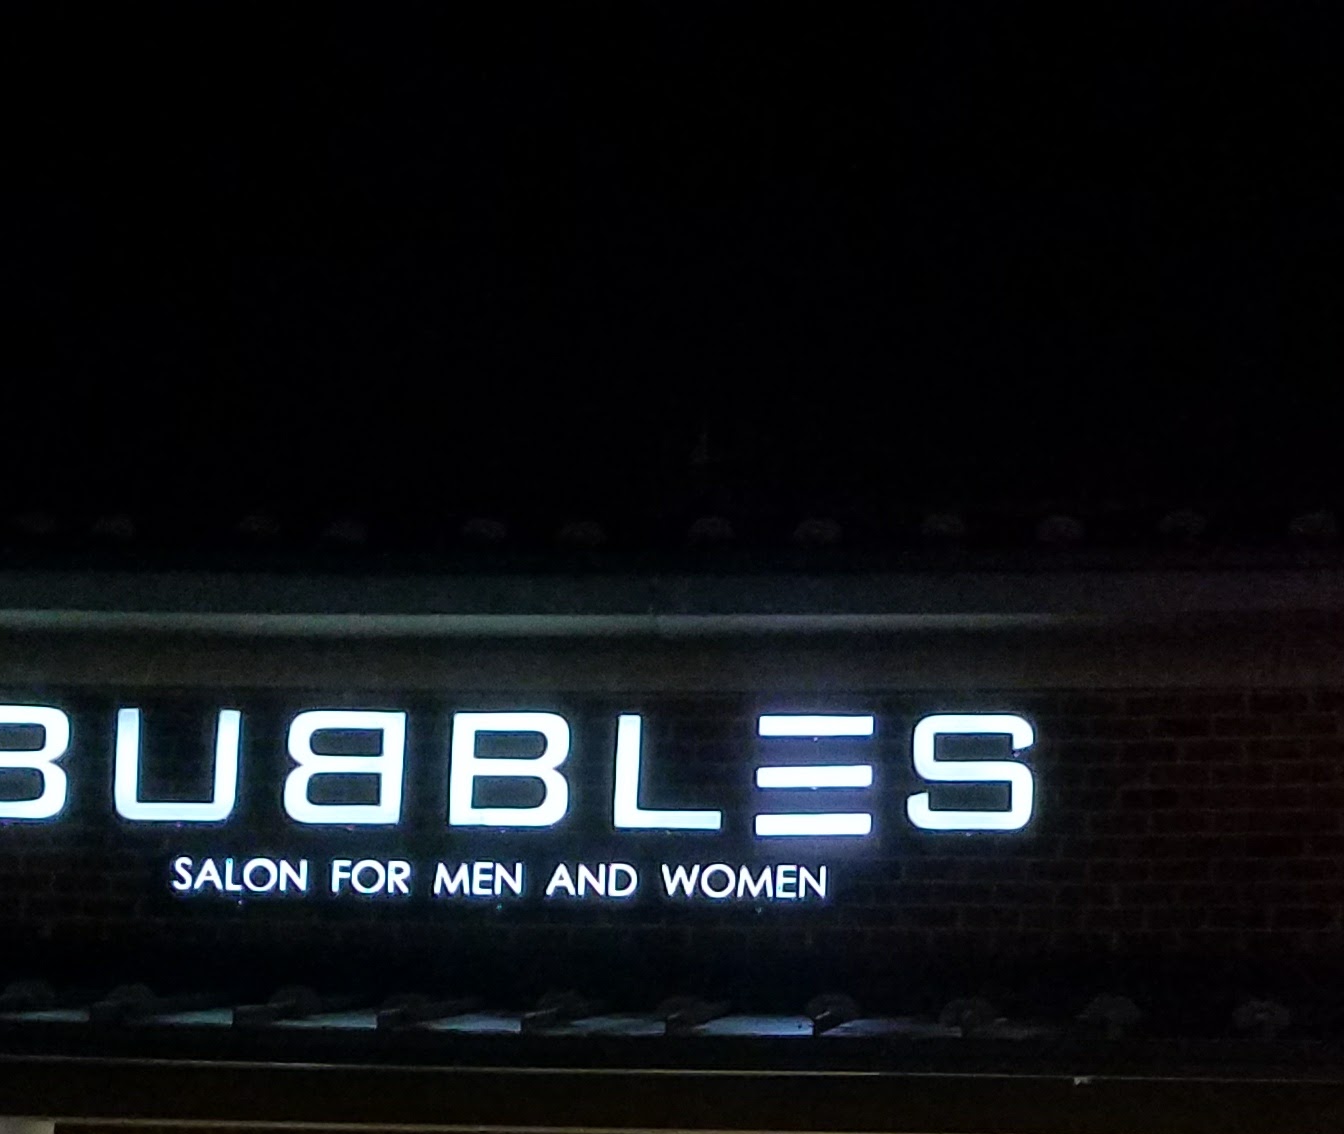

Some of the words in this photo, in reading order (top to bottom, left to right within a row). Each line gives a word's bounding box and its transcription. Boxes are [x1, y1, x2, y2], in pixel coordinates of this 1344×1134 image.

[172, 857, 308, 893] SALON
[331, 859, 412, 895] FOR
[434, 861, 523, 897] MEN
[546, 863, 638, 898] AND
[662, 863, 827, 900] WOMEN
